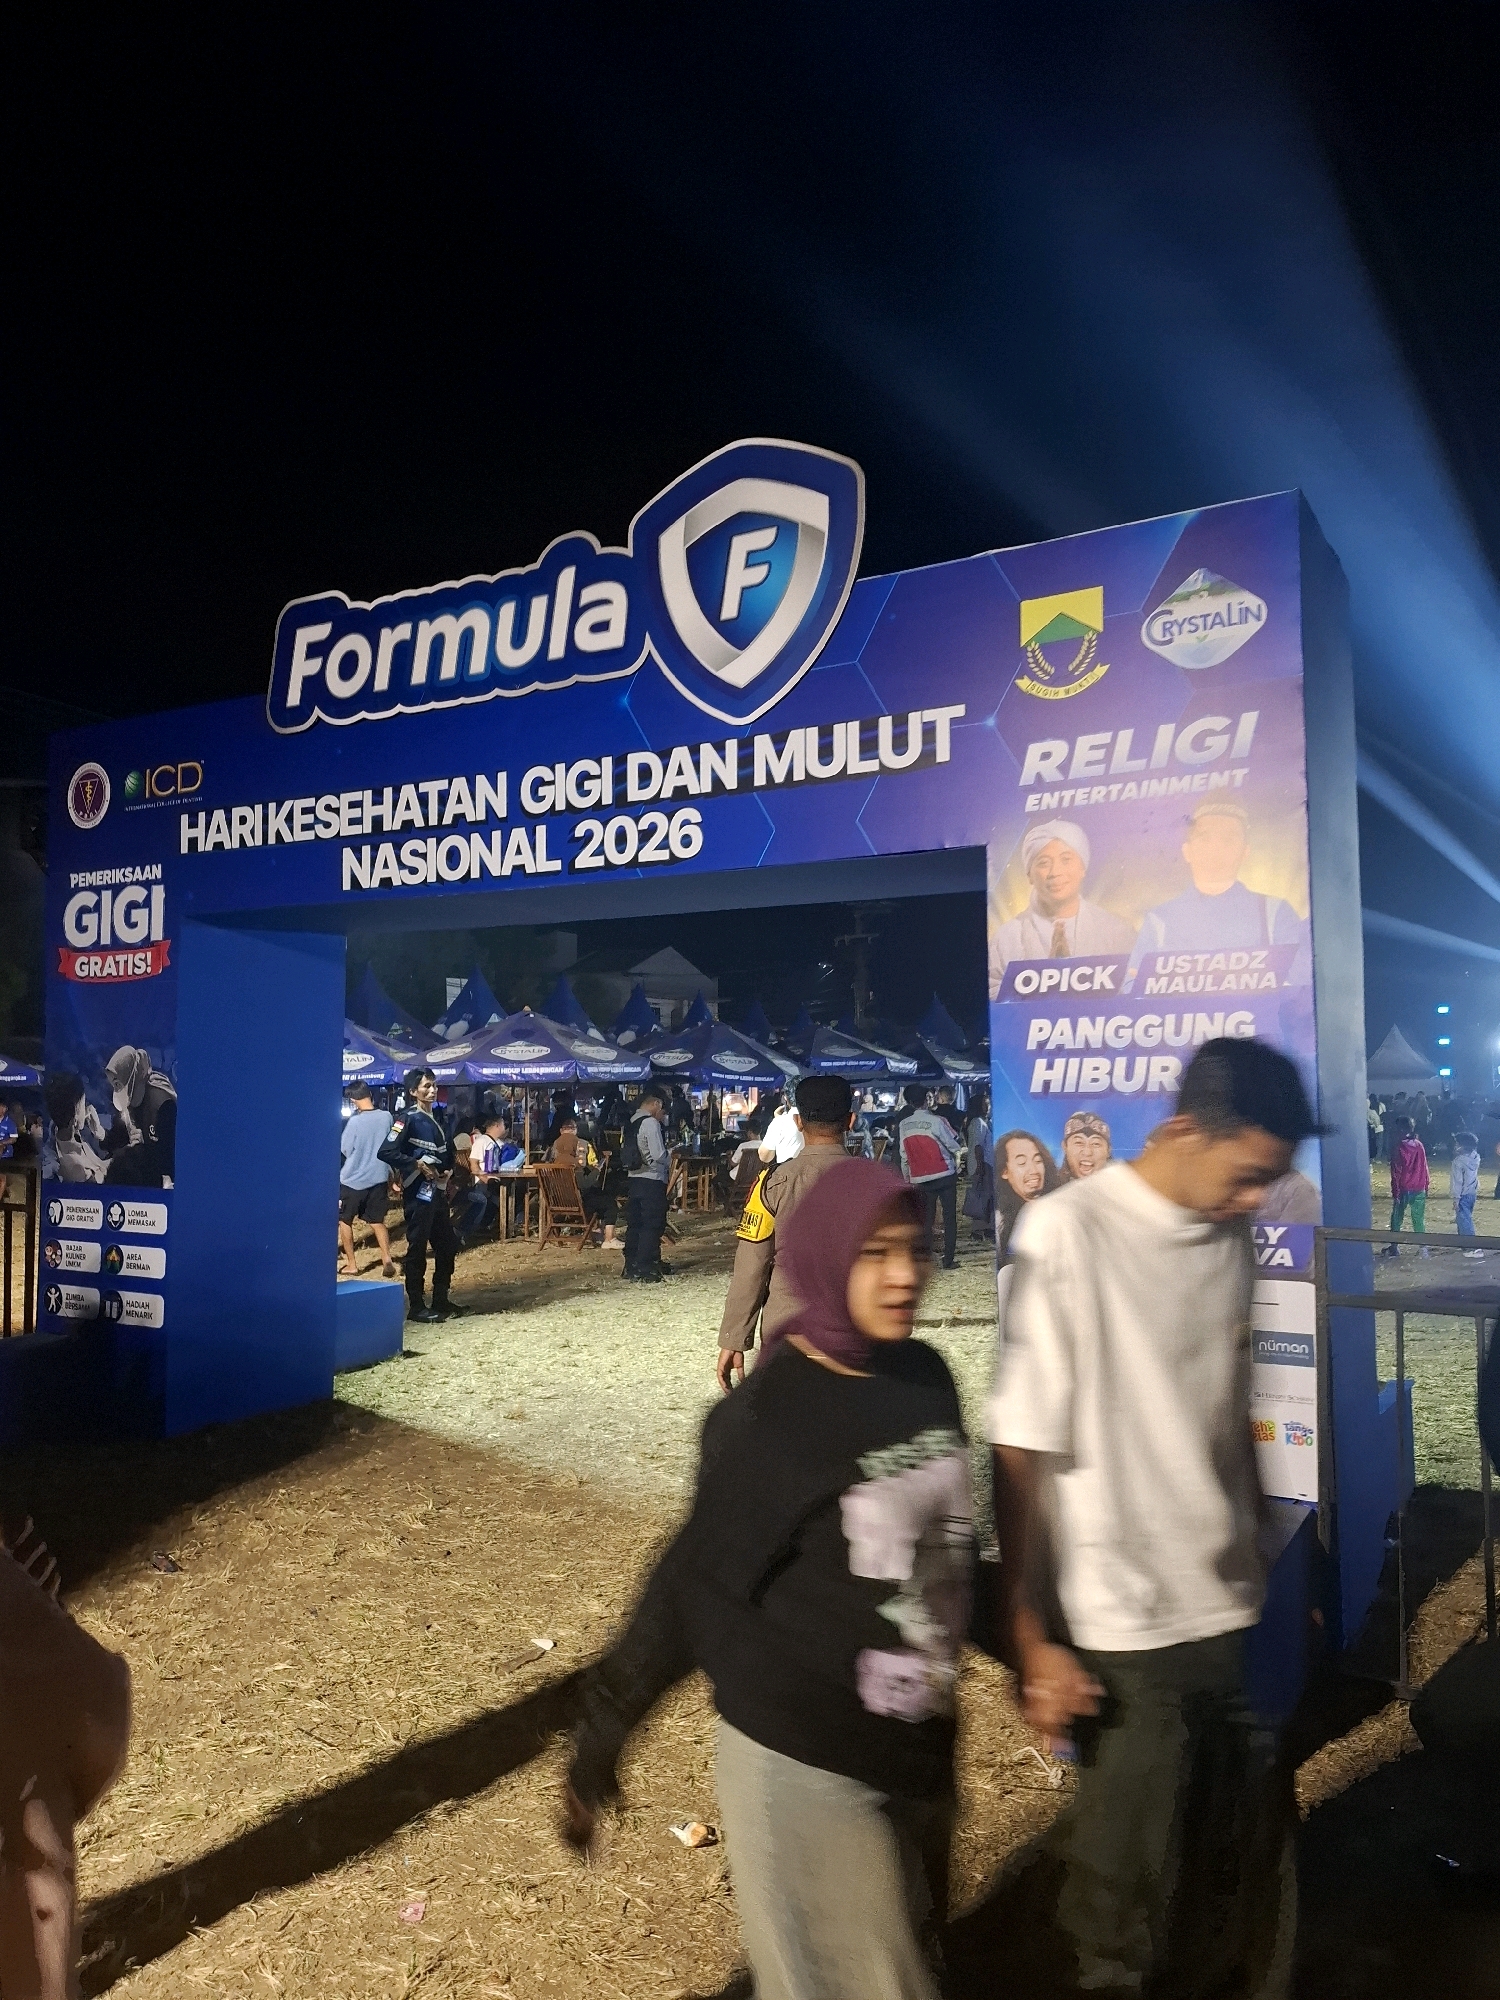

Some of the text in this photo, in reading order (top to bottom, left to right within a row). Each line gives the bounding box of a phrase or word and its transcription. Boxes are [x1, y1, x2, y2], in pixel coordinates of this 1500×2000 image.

[720, 525, 778, 621] F
[286, 564, 628, 708] Formula
[1019, 711, 1260, 787] RELIGI
[145, 761, 203, 799] ICD
[180, 703, 966, 854] HARI KESEHATAN GIGI DAN MULUT
[1024, 767, 1249, 813] ENTERTAINMENT
[342, 807, 704, 890] NASIONAL 2026
[70, 864, 162, 888] PEMERIKSAAN
[63, 884, 166, 948] GIGI
[74, 951, 152, 978] GRATIS!
[1155, 950, 1269, 975] USTADZ
[1013, 964, 1119, 995] OPICK
[1144, 971, 1278, 995] MAULANA
[1026, 1010, 1256, 1051] PANGGUNG
[1029, 1056, 1184, 1094] HIBUR
[127, 1219, 156, 1228] MEMASAK
[128, 1209, 148, 1218] LOMBA
[125, 1262, 151, 1271] BERMAIN
[126, 1253, 142, 1262] AREA
[125, 1300, 150, 1310] HADIAH
[125, 1310, 154, 1321] MENARIK
[1258, 1340, 1309, 1354] nüman
